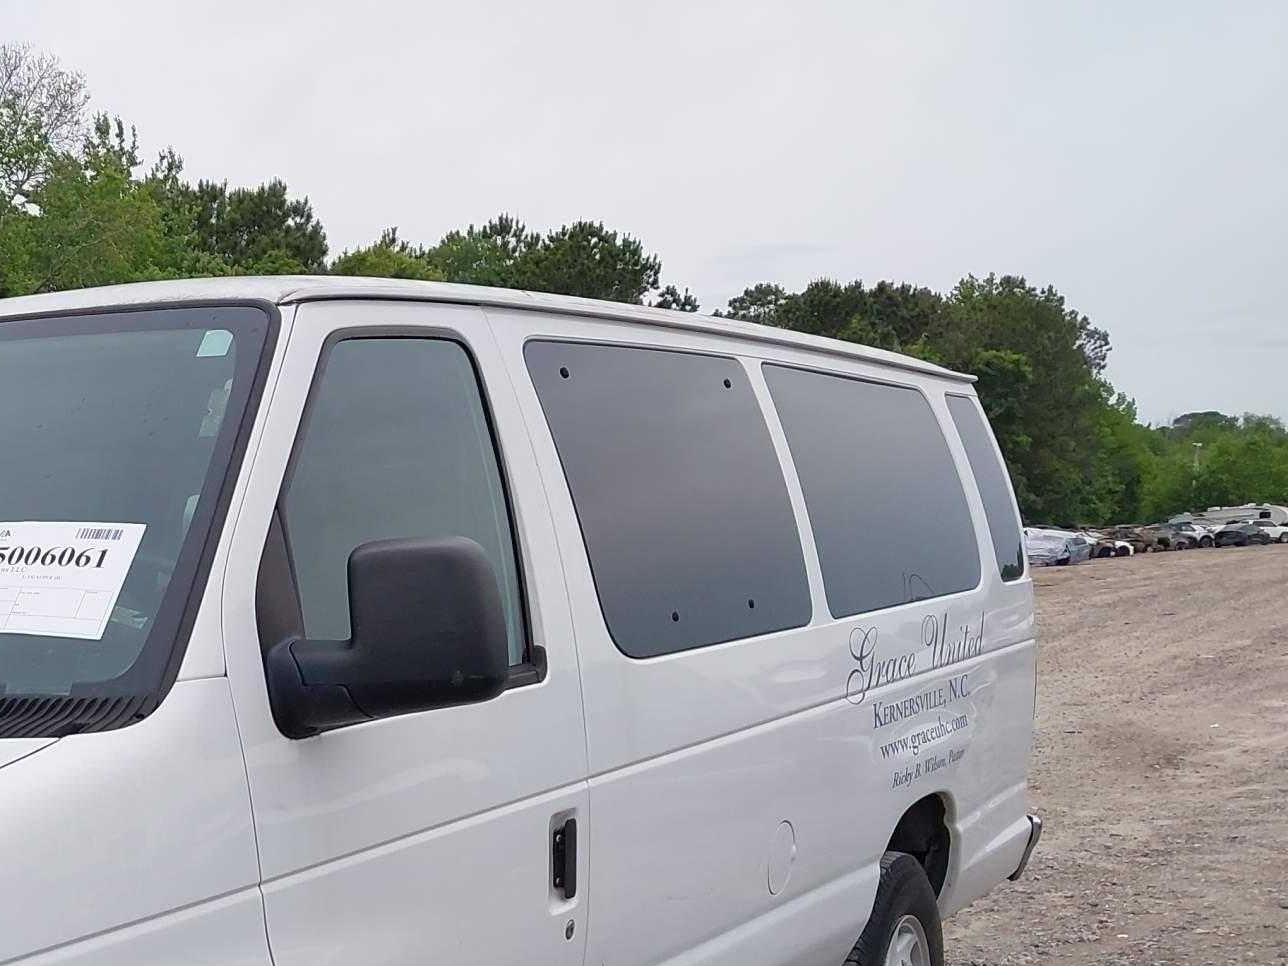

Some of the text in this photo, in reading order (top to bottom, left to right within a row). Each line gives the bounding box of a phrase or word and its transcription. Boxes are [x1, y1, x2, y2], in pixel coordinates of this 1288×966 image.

[845, 611, 985, 705] Grace United
[873, 674, 971, 729] KERNERSVILLE, N.C.
[880, 713, 968, 760] www.graceuhc.com
